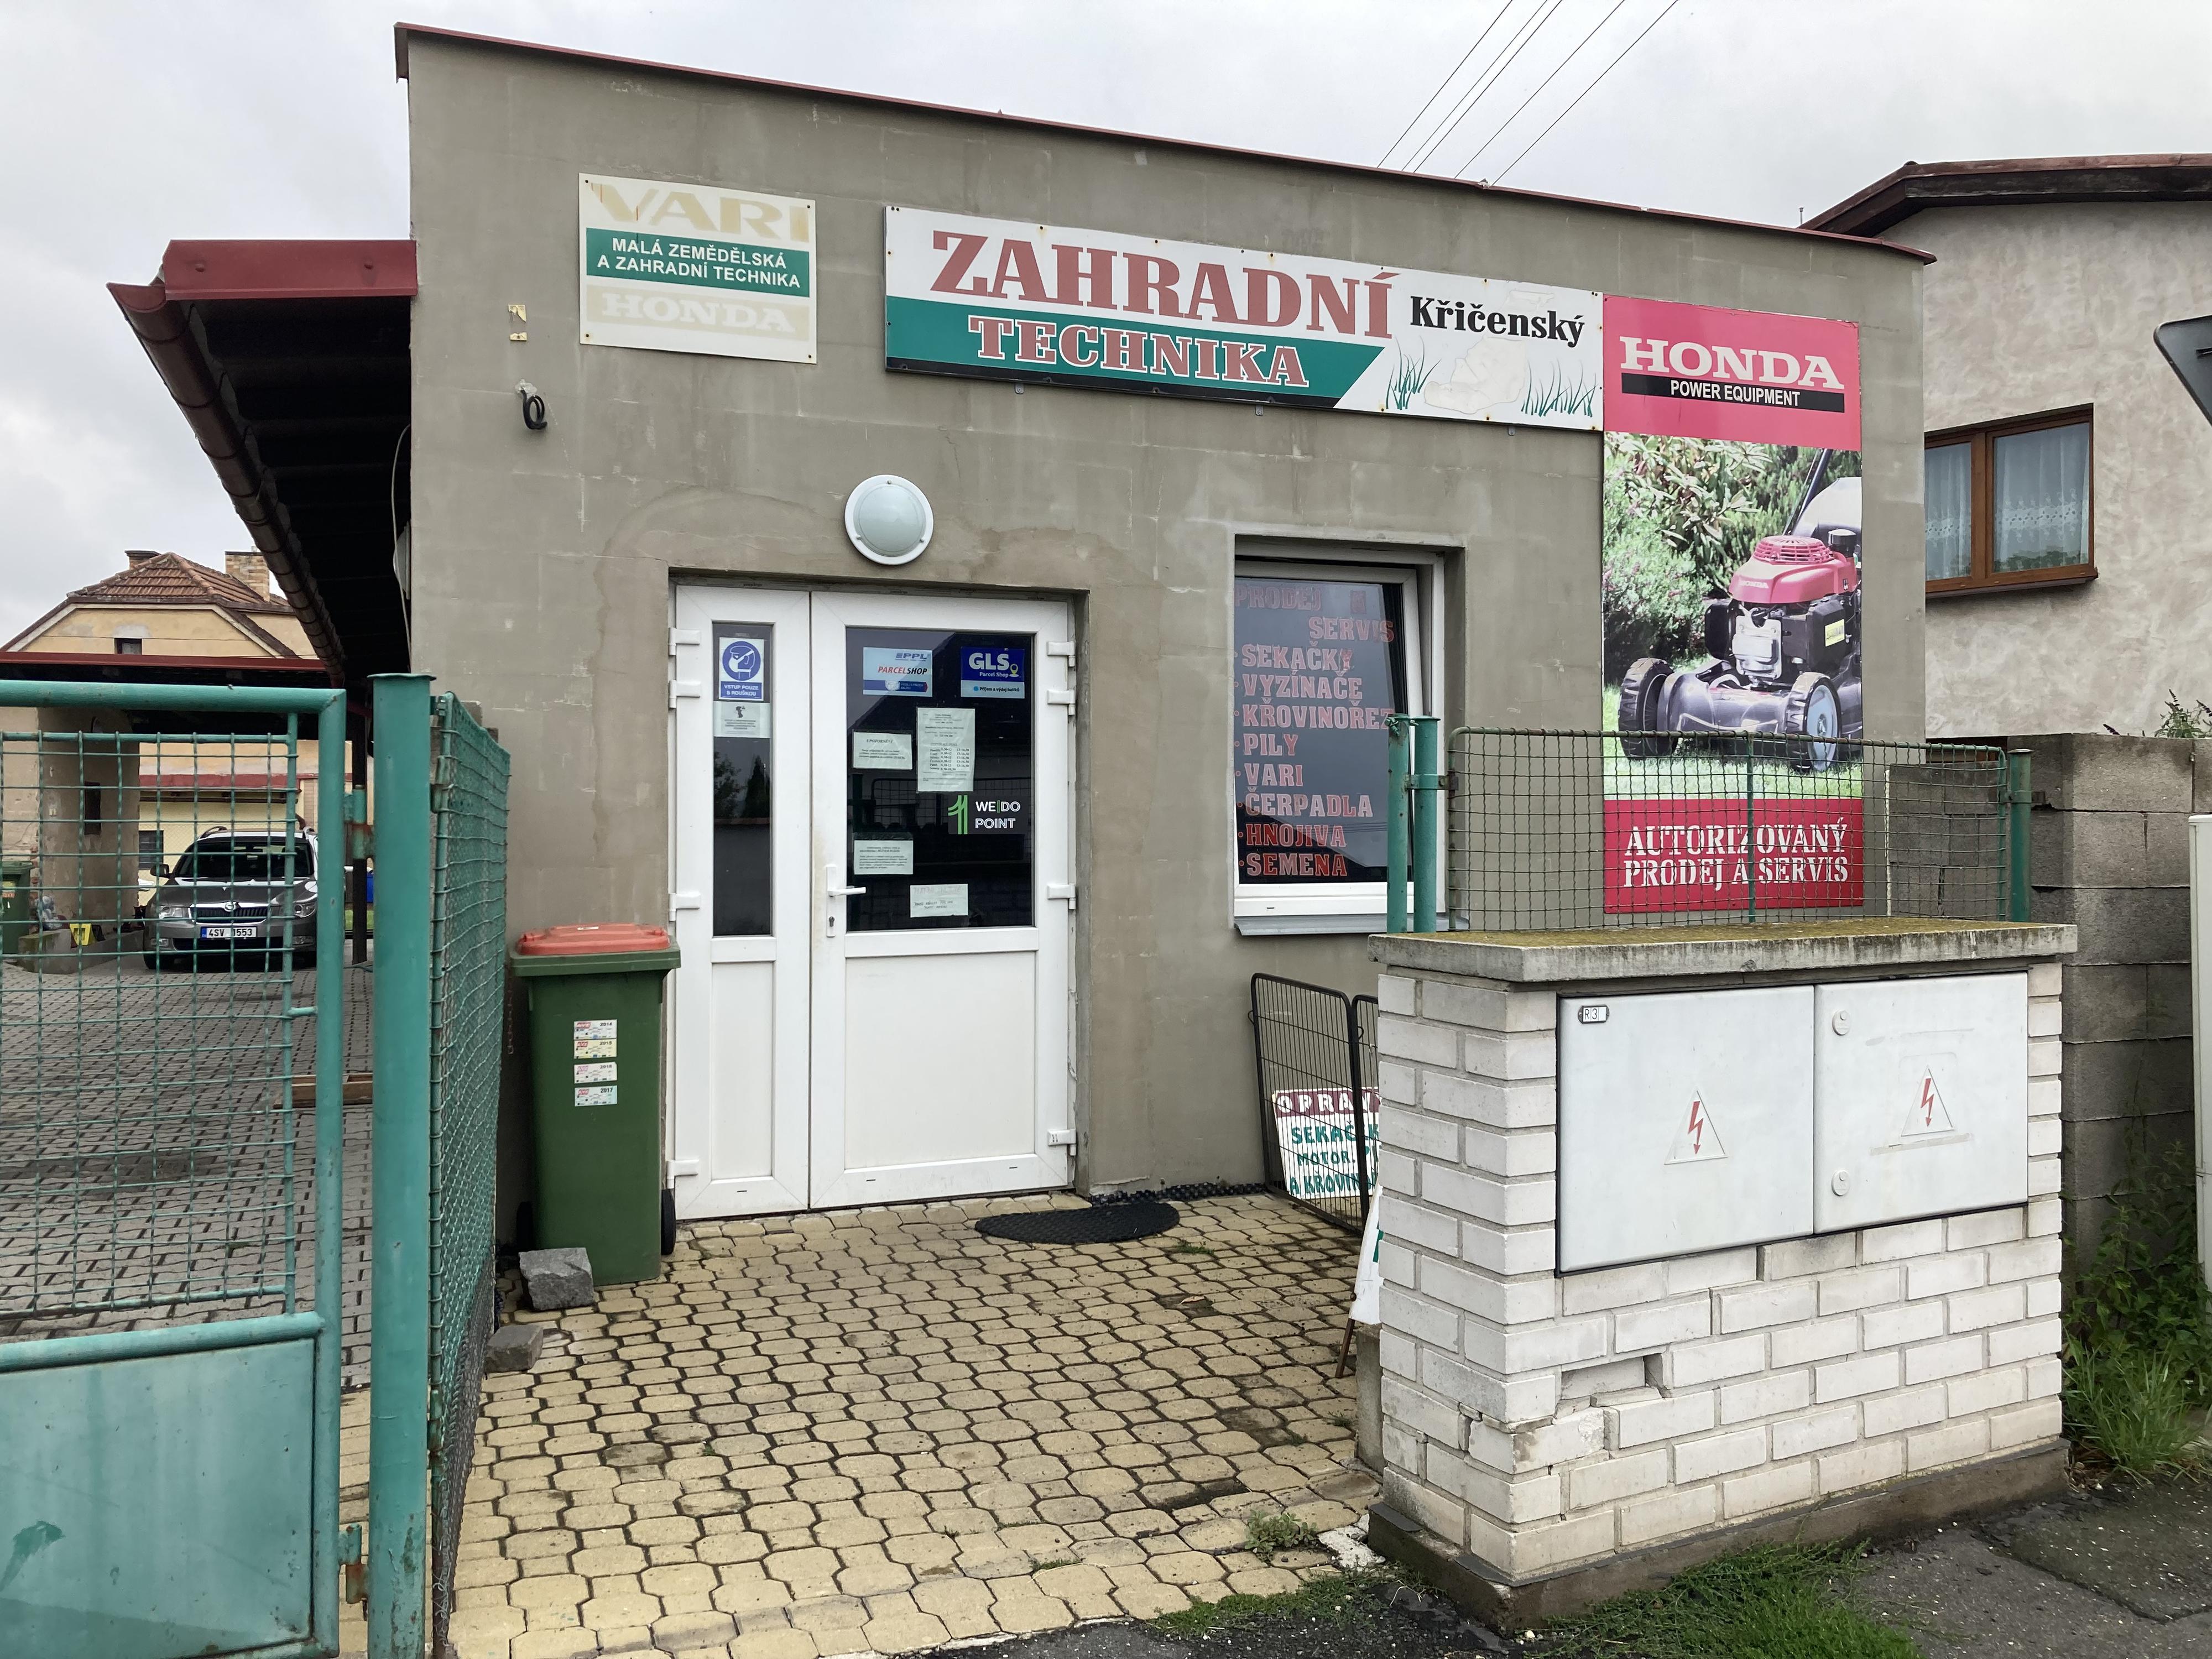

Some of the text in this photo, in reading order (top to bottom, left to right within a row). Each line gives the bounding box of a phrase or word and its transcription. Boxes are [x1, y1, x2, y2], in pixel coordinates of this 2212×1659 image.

[588, 182, 810, 243] VARI
[612, 237, 787, 269] MALÁ ZEMĚDĚLSKÁ
[597, 255, 800, 288] A ZAHRADNÍ TECHNIKA
[930, 231, 1401, 339] ZAHRADNÍ
[601, 293, 796, 332] HONDA
[1410, 296, 1585, 347] Křičenský
[968, 315, 1309, 387] TECHNIKA
[1620, 336, 1844, 389] HONDA
[1671, 380, 1800, 406] POWER EQUIPMENT
[1308, 617, 1394, 643] SERVIS
[969, 653, 1010, 671] GLS
[1241, 640, 1353, 671] SEKAČKY
[878, 666, 928, 675] PARCELSHOP
[1243, 733, 1298, 756] PILY
[1244, 763, 1303, 786] VARI
[1245, 787, 1373, 817] ČERPADLA
[975, 818, 1016, 829] POINT
[1246, 823, 1346, 847] HNOJIVA
[1625, 817, 1848, 856] AUTORIZOVANÝ
[1247, 853, 1348, 877] SEMENA
[1624, 855, 1848, 891] PRODEJ A SERVIS
[208, 928, 225, 937] 4SV
[1297, 1151, 1356, 1166] MOTOR.
[1290, 1176, 1300, 1195] A
